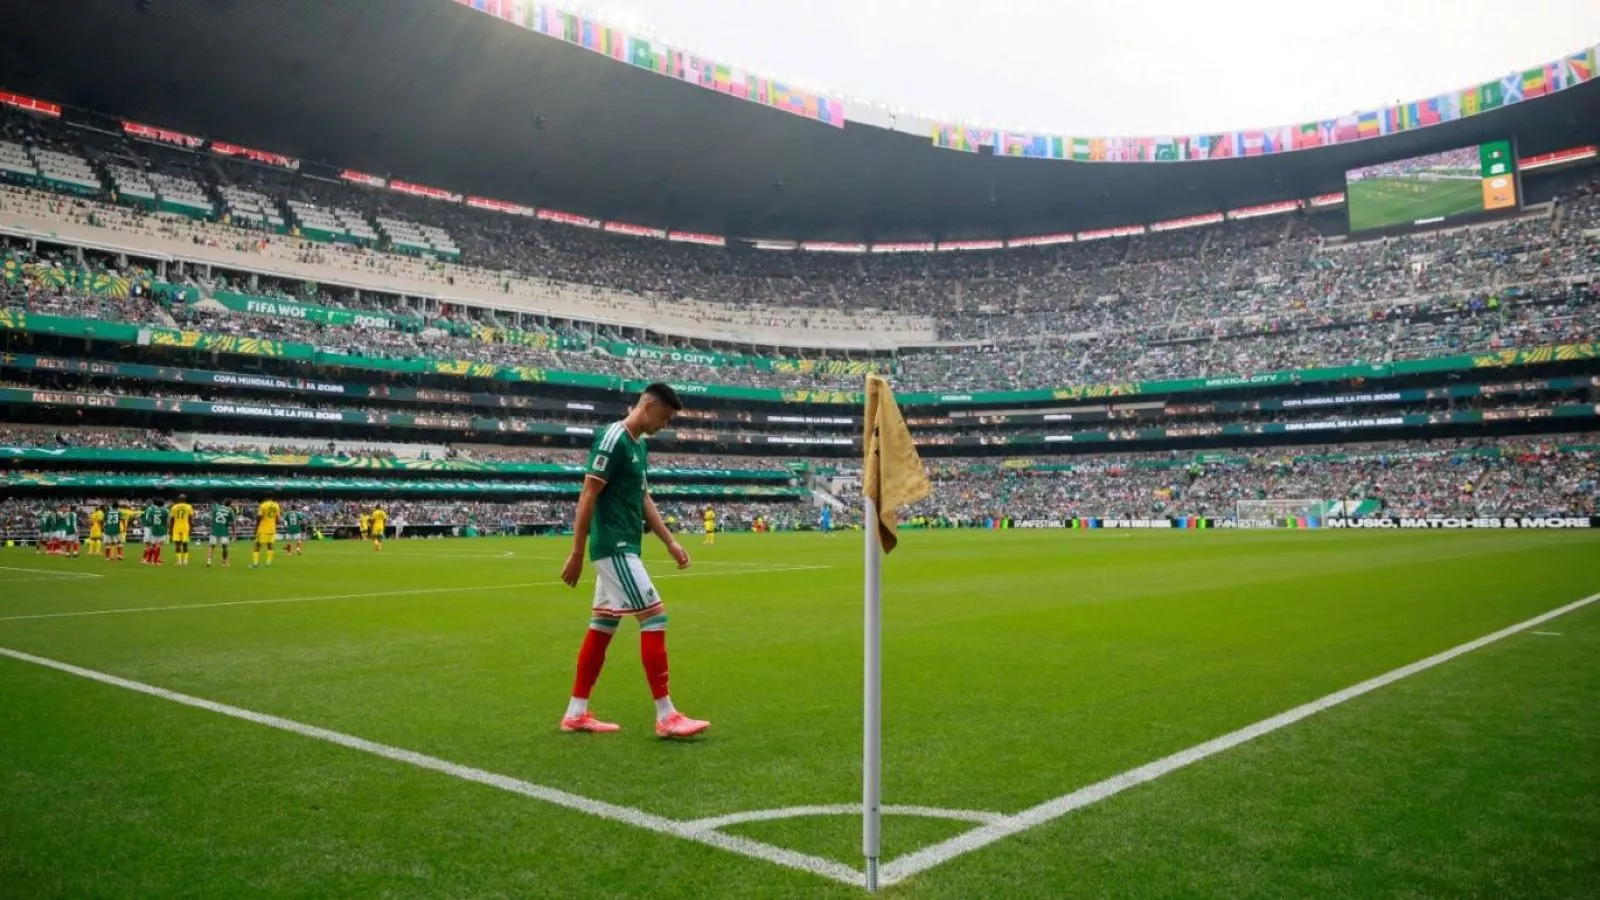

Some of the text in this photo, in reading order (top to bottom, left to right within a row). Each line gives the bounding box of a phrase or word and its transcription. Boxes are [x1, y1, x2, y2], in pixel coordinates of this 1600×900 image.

[247, 301, 276, 314] FIFA
[684, 352, 716, 364] CITY
[213, 374, 236, 384] COPA
[238, 376, 274, 388] MUNDIAL
[1251, 374, 1277, 383] CITY
[88, 394, 117, 407] CITY
[211, 404, 234, 414] COPA
[236, 406, 272, 416] MUNDIAL
[275, 408, 285, 418] DE
[286, 409, 296, 418] LA
[297, 410, 314, 419] FIFA
[107, 514, 119, 524] 23
[176, 510, 186, 520] 17
[1400, 518, 1502, 528] MATCHES
[1504, 518, 1518, 528] &
[1522, 517, 1591, 528] MORE
